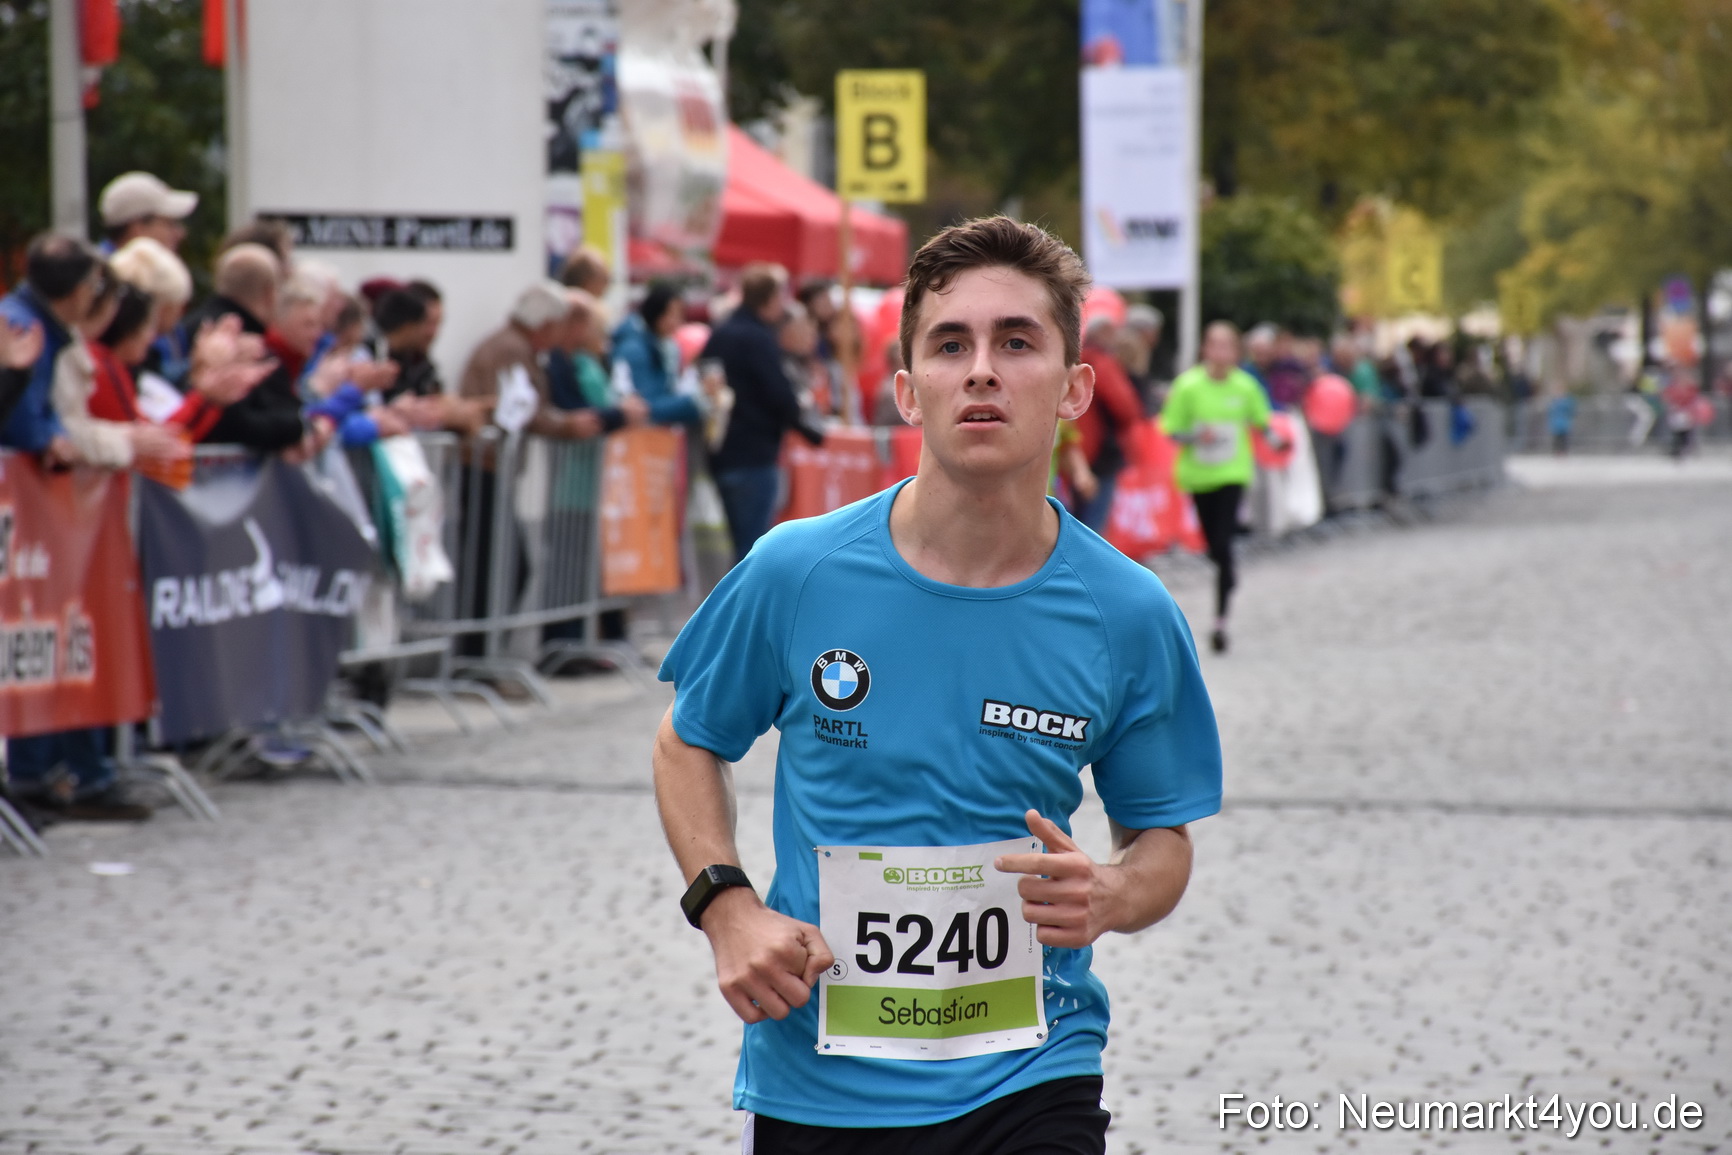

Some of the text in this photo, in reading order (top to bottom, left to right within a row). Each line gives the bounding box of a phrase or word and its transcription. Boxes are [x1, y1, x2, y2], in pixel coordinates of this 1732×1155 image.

[862, 113, 901, 171] B
[816, 651, 866, 673] BMW
[813, 714, 868, 737] PARTL
[981, 699, 1092, 742] BOCK
[814, 729, 868, 749] Neumarkt
[979, 726, 1015, 739] inspired
[1017, 732, 1028, 744] by
[1029, 736, 1052, 747] smart
[906, 865, 984, 885] BOCK
[855, 907, 1009, 976] 5240
[832, 964, 841, 976] S
[878, 995, 988, 1026] Sebastian
